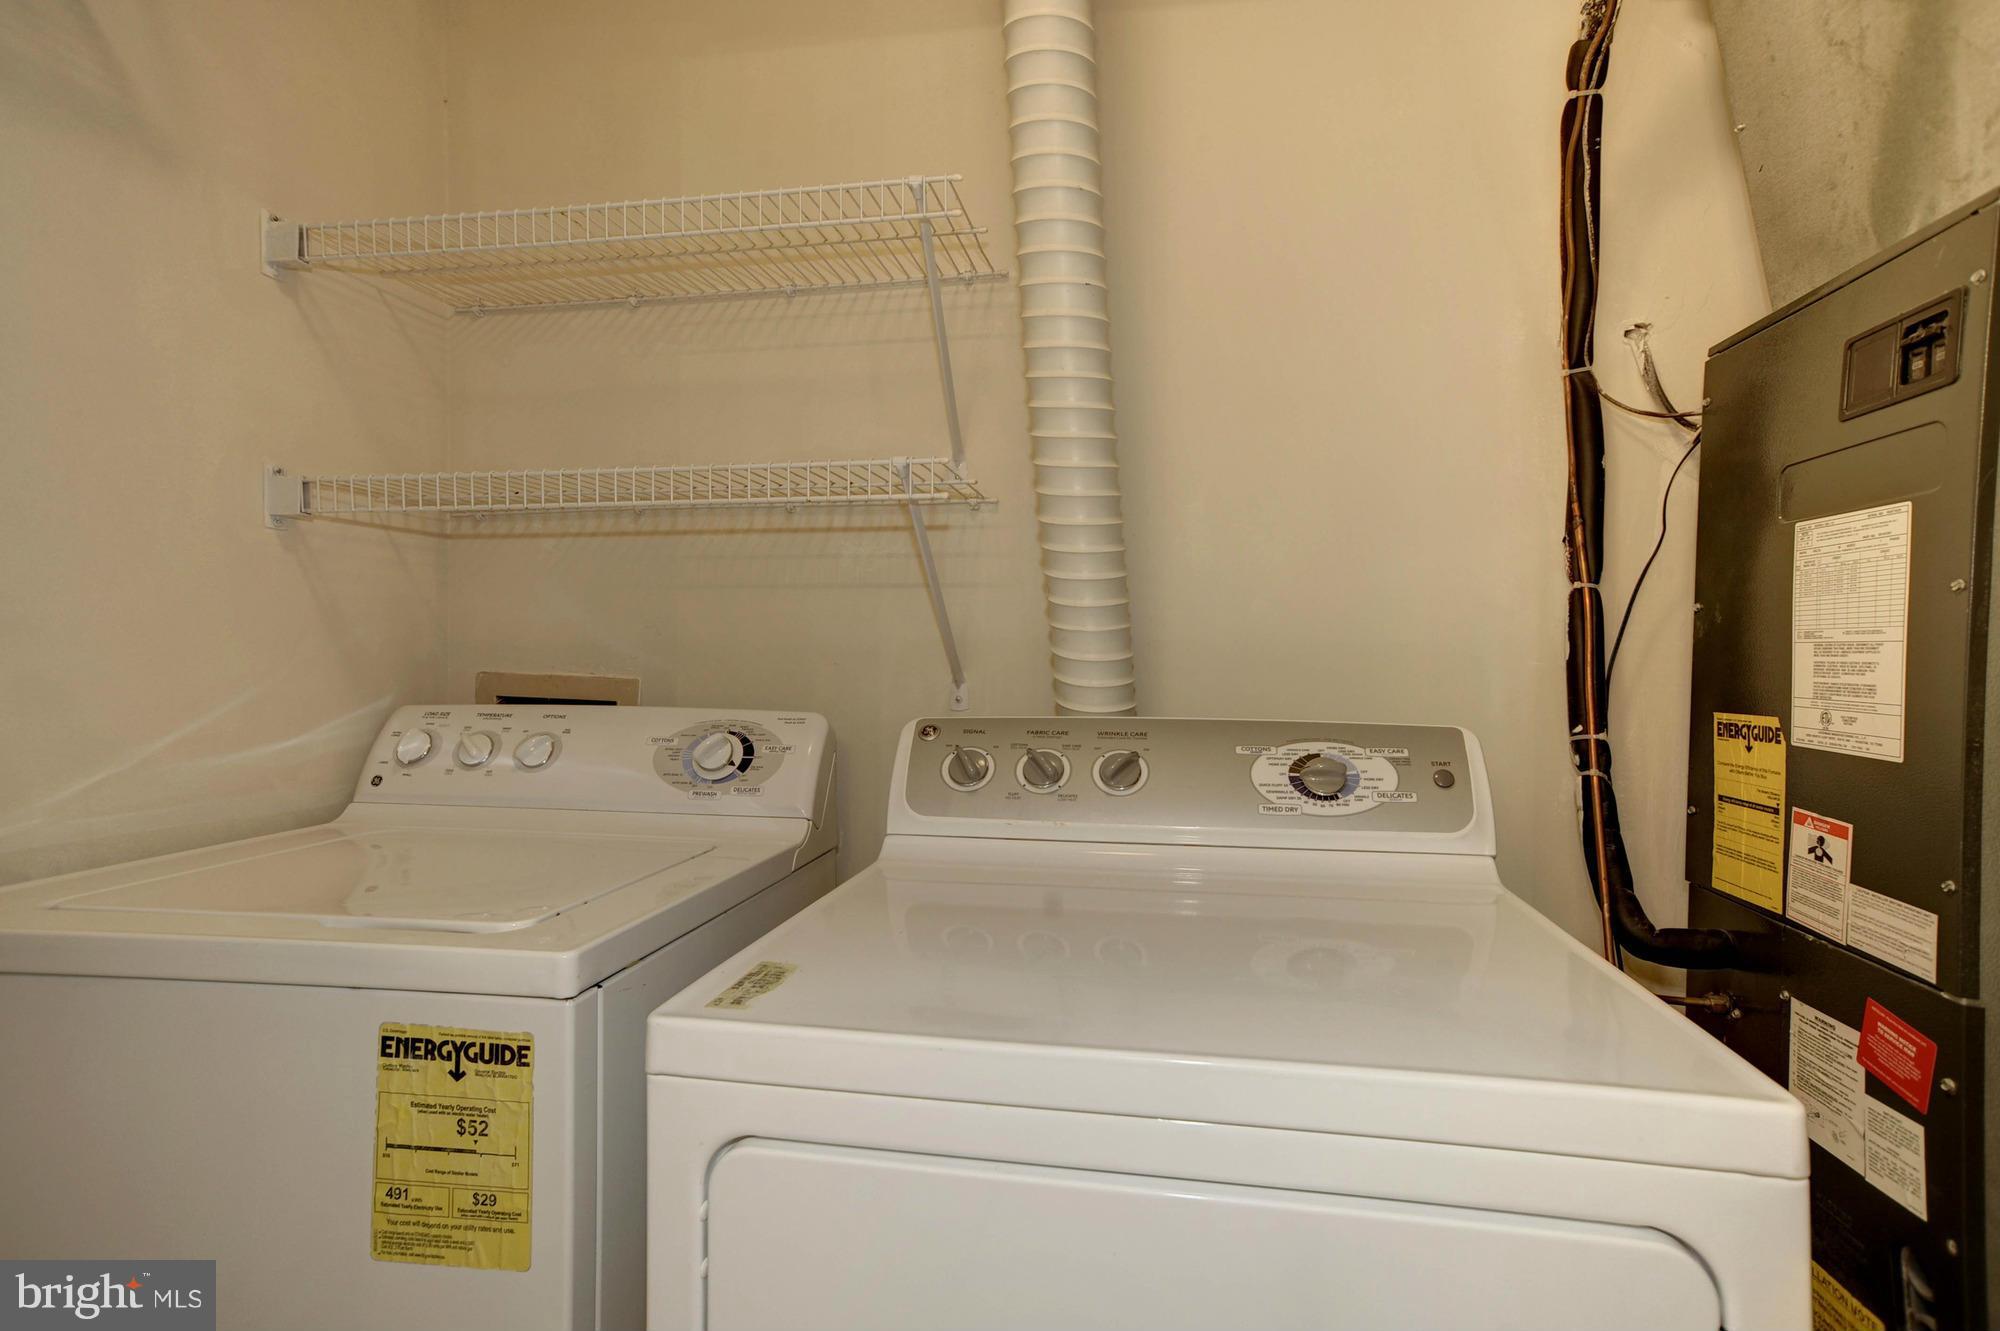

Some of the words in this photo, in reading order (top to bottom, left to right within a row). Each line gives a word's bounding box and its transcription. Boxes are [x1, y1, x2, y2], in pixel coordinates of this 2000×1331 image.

[1717, 721, 1782, 744] ENERGYGUIDE
[380, 1035, 531, 1067] ENERGYGUIDE
[410, 1101, 437, 1109] Estimated
[438, 1103, 455, 1111] Yearly
[455, 1104, 482, 1114] Operating
[483, 1106, 496, 1114] Cost
[456, 1117, 489, 1137] $52
[385, 1186, 409, 1201] 491
[472, 1191, 497, 1207] $29
[421, 1221, 441, 1230] depend
[463, 1224, 477, 1232] utility
